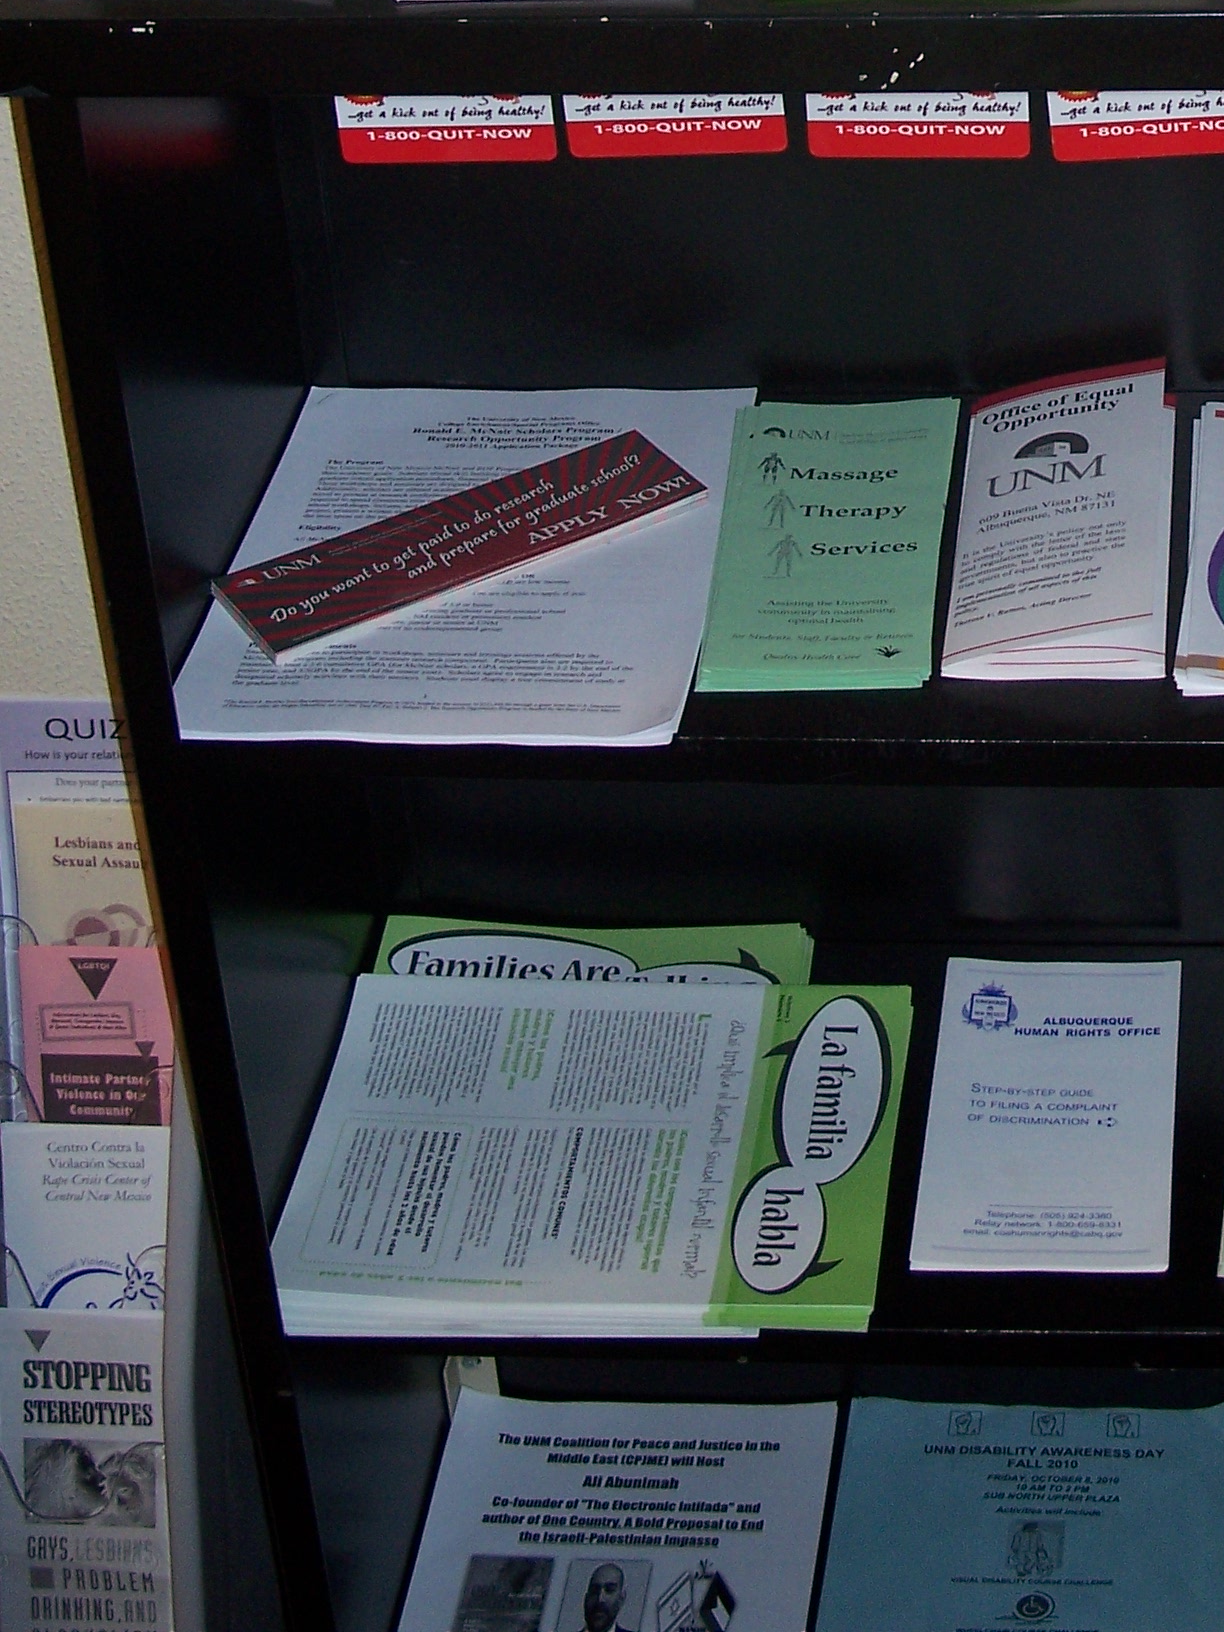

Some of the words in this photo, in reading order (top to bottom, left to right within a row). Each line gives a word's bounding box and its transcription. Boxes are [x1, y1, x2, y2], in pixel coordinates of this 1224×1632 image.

[367, 129, 532, 142] 1-800-QUIT-NOW
[594, 120, 761, 134] 1-800-QUIT-NOW
[835, 121, 1007, 139] 1-800-QUIT-NOW
[982, 403, 1042, 425] Office
[1048, 393, 1069, 408] of
[1074, 383, 1134, 402] Equal
[992, 399, 1120, 433] Opportunity
[789, 463, 899, 485] Massage
[986, 453, 1107, 498] UNM
[528, 505, 609, 545] APPLY
[618, 475, 692, 510] NOW!
[800, 500, 908, 524] Therapy
[810, 537, 918, 558] Services
[262, 553, 322, 583] UNM
[1014, 1027, 1061, 1037] HUMAN
[1065, 1026, 1112, 1037] RIGHTS
[1117, 1026, 1161, 1037] OFFICE
[1043, 1015, 1134, 1027] ALBUQUERQUE
[823, 1023, 858, 1058] La
[803, 1064, 857, 1162] familia
[751, 1186, 805, 1269] habla
[23, 1359, 152, 1393] STOPPING
[23, 1400, 153, 1427] STEREOTYPES
